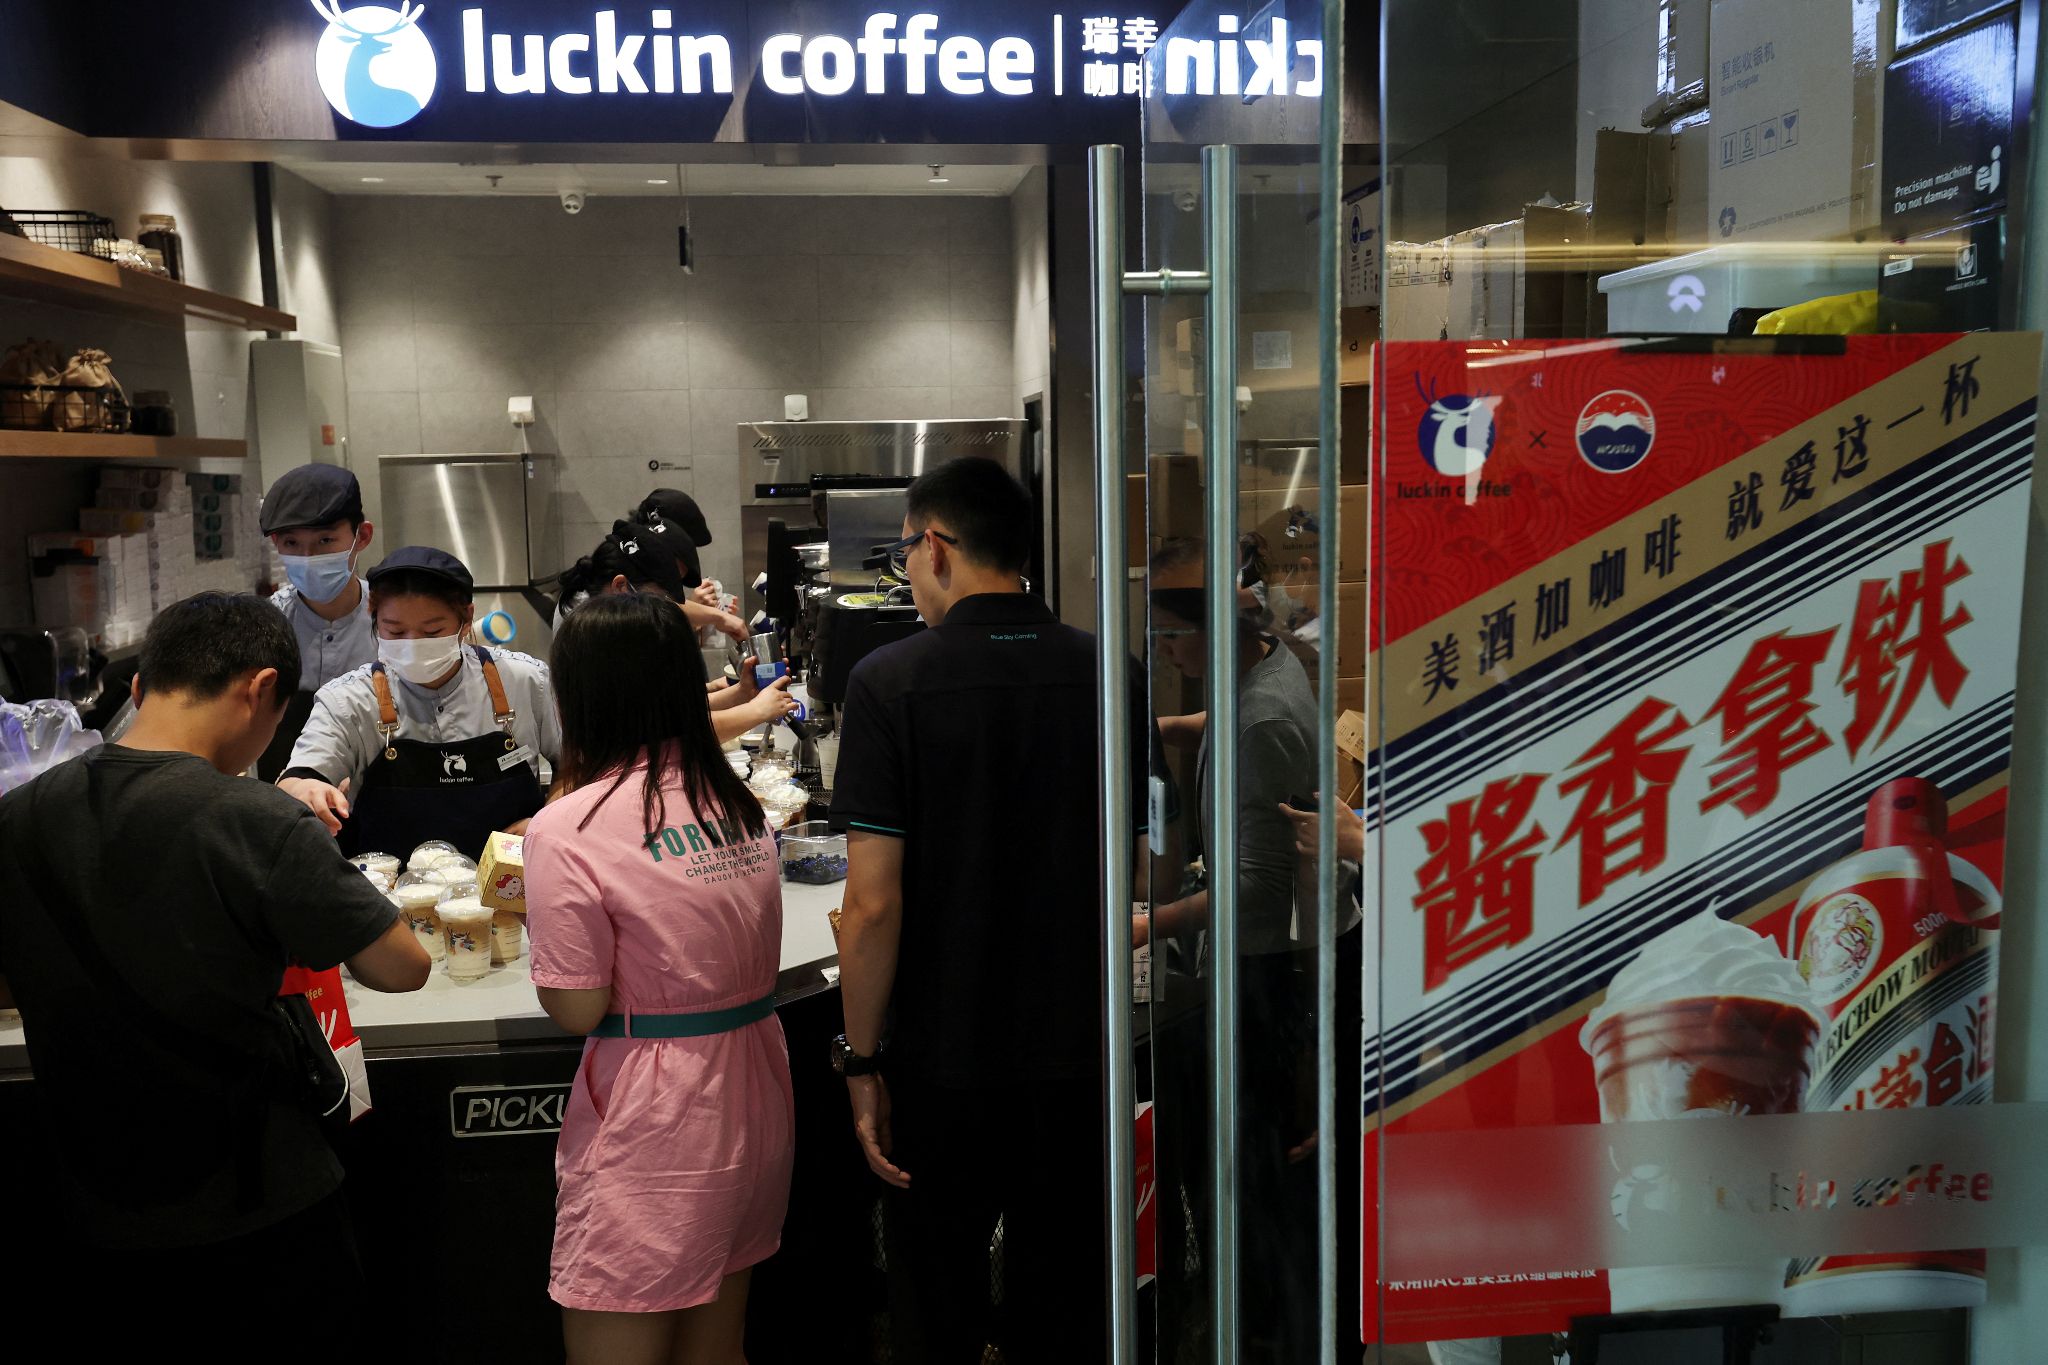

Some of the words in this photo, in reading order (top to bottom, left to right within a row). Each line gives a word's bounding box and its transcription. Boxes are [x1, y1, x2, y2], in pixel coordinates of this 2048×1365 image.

[462, 8, 733, 94] luckin
[761, 12, 1035, 96] coffee
[1082, 16, 1158, 54] 瑞幸
[1083, 60, 1153, 98] 咖啡
[1894, 177, 1934, 199] Precision
[1935, 164, 1974, 185] machine
[1894, 201, 1907, 214] Do
[1907, 196, 1923, 210] not
[1924, 185, 1960, 205] damage
[1397, 481, 1452, 498] luckin
[1455, 480, 1513, 498] cffee
[1421, 512, 1684, 704] 美酒加咖啡
[1724, 355, 1982, 541] 就爱这一杯
[1411, 536, 1974, 995] 酱香拿铁
[685, 862, 728, 878] CHANGE
[728, 859, 744, 871] THE
[690, 854, 712, 865] LET
[713, 847, 738, 861] YOUR
[1852, 1162, 1994, 1209] coffee
